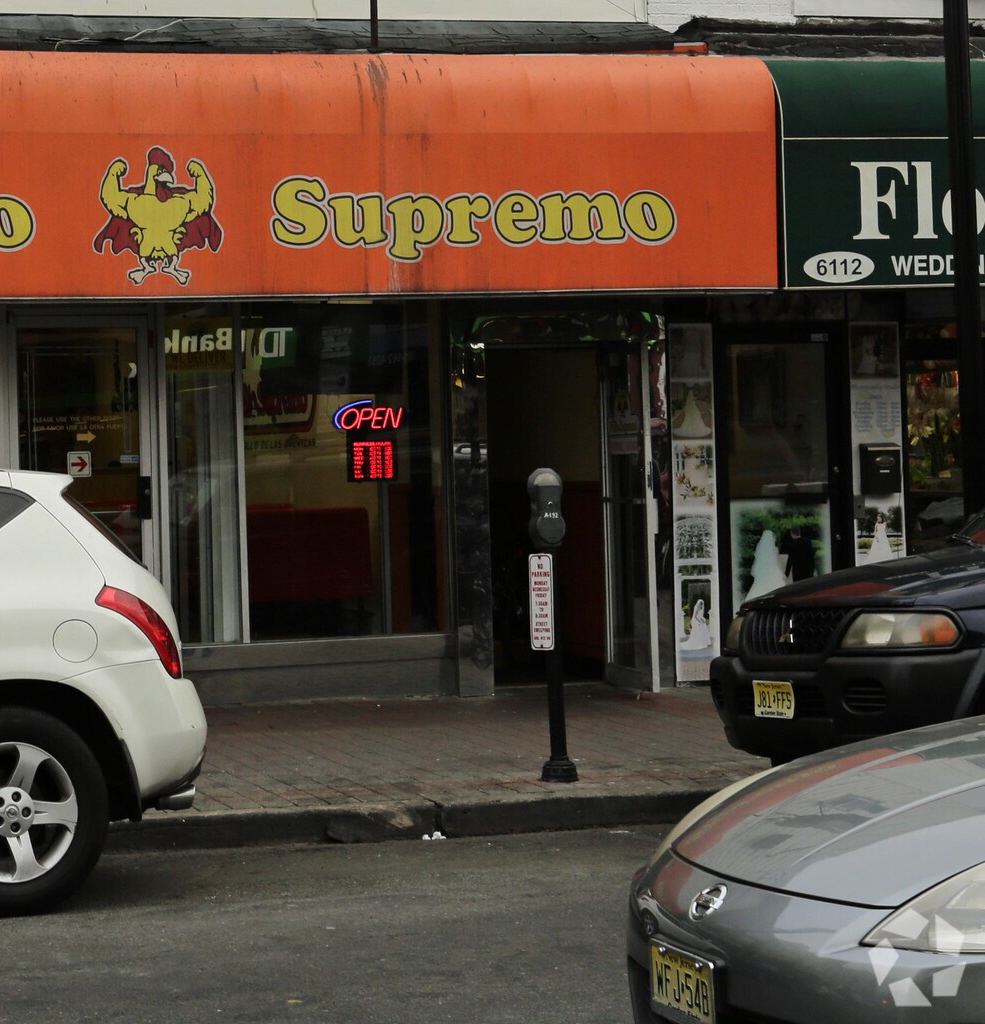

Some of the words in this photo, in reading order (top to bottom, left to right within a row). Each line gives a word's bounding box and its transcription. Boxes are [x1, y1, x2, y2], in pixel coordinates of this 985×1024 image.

[271, 174, 678, 263] Supremo
[816, 258, 862, 276] 6112
[340, 407, 404, 430] OPEN
